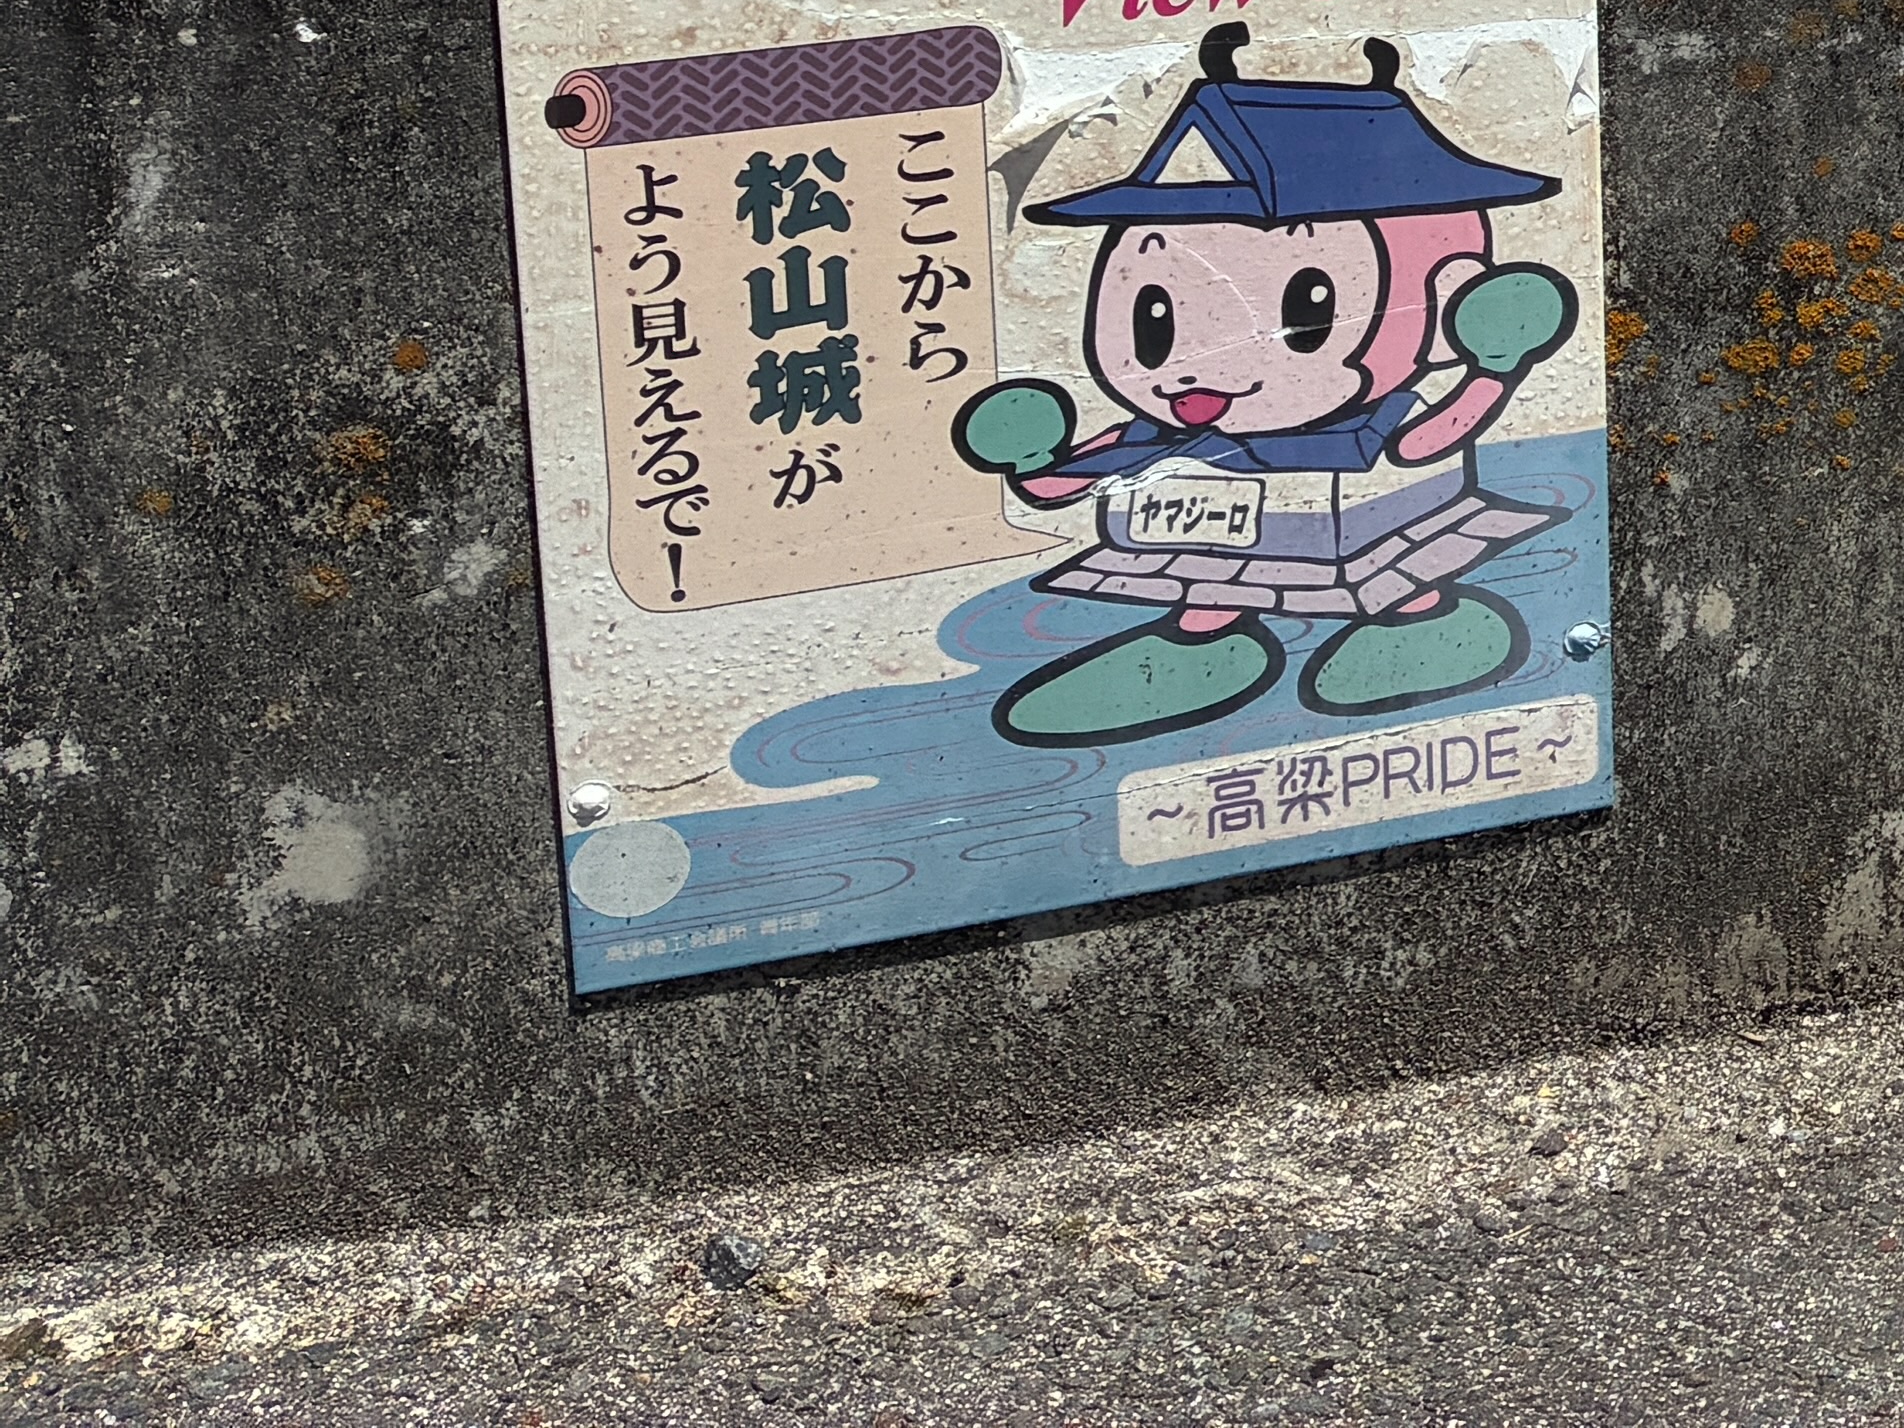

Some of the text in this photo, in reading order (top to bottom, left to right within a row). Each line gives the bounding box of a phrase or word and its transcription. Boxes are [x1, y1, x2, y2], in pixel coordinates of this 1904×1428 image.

[897, 130, 972, 383] ここから
[1140, 494, 1250, 535] ヤマジーロ
